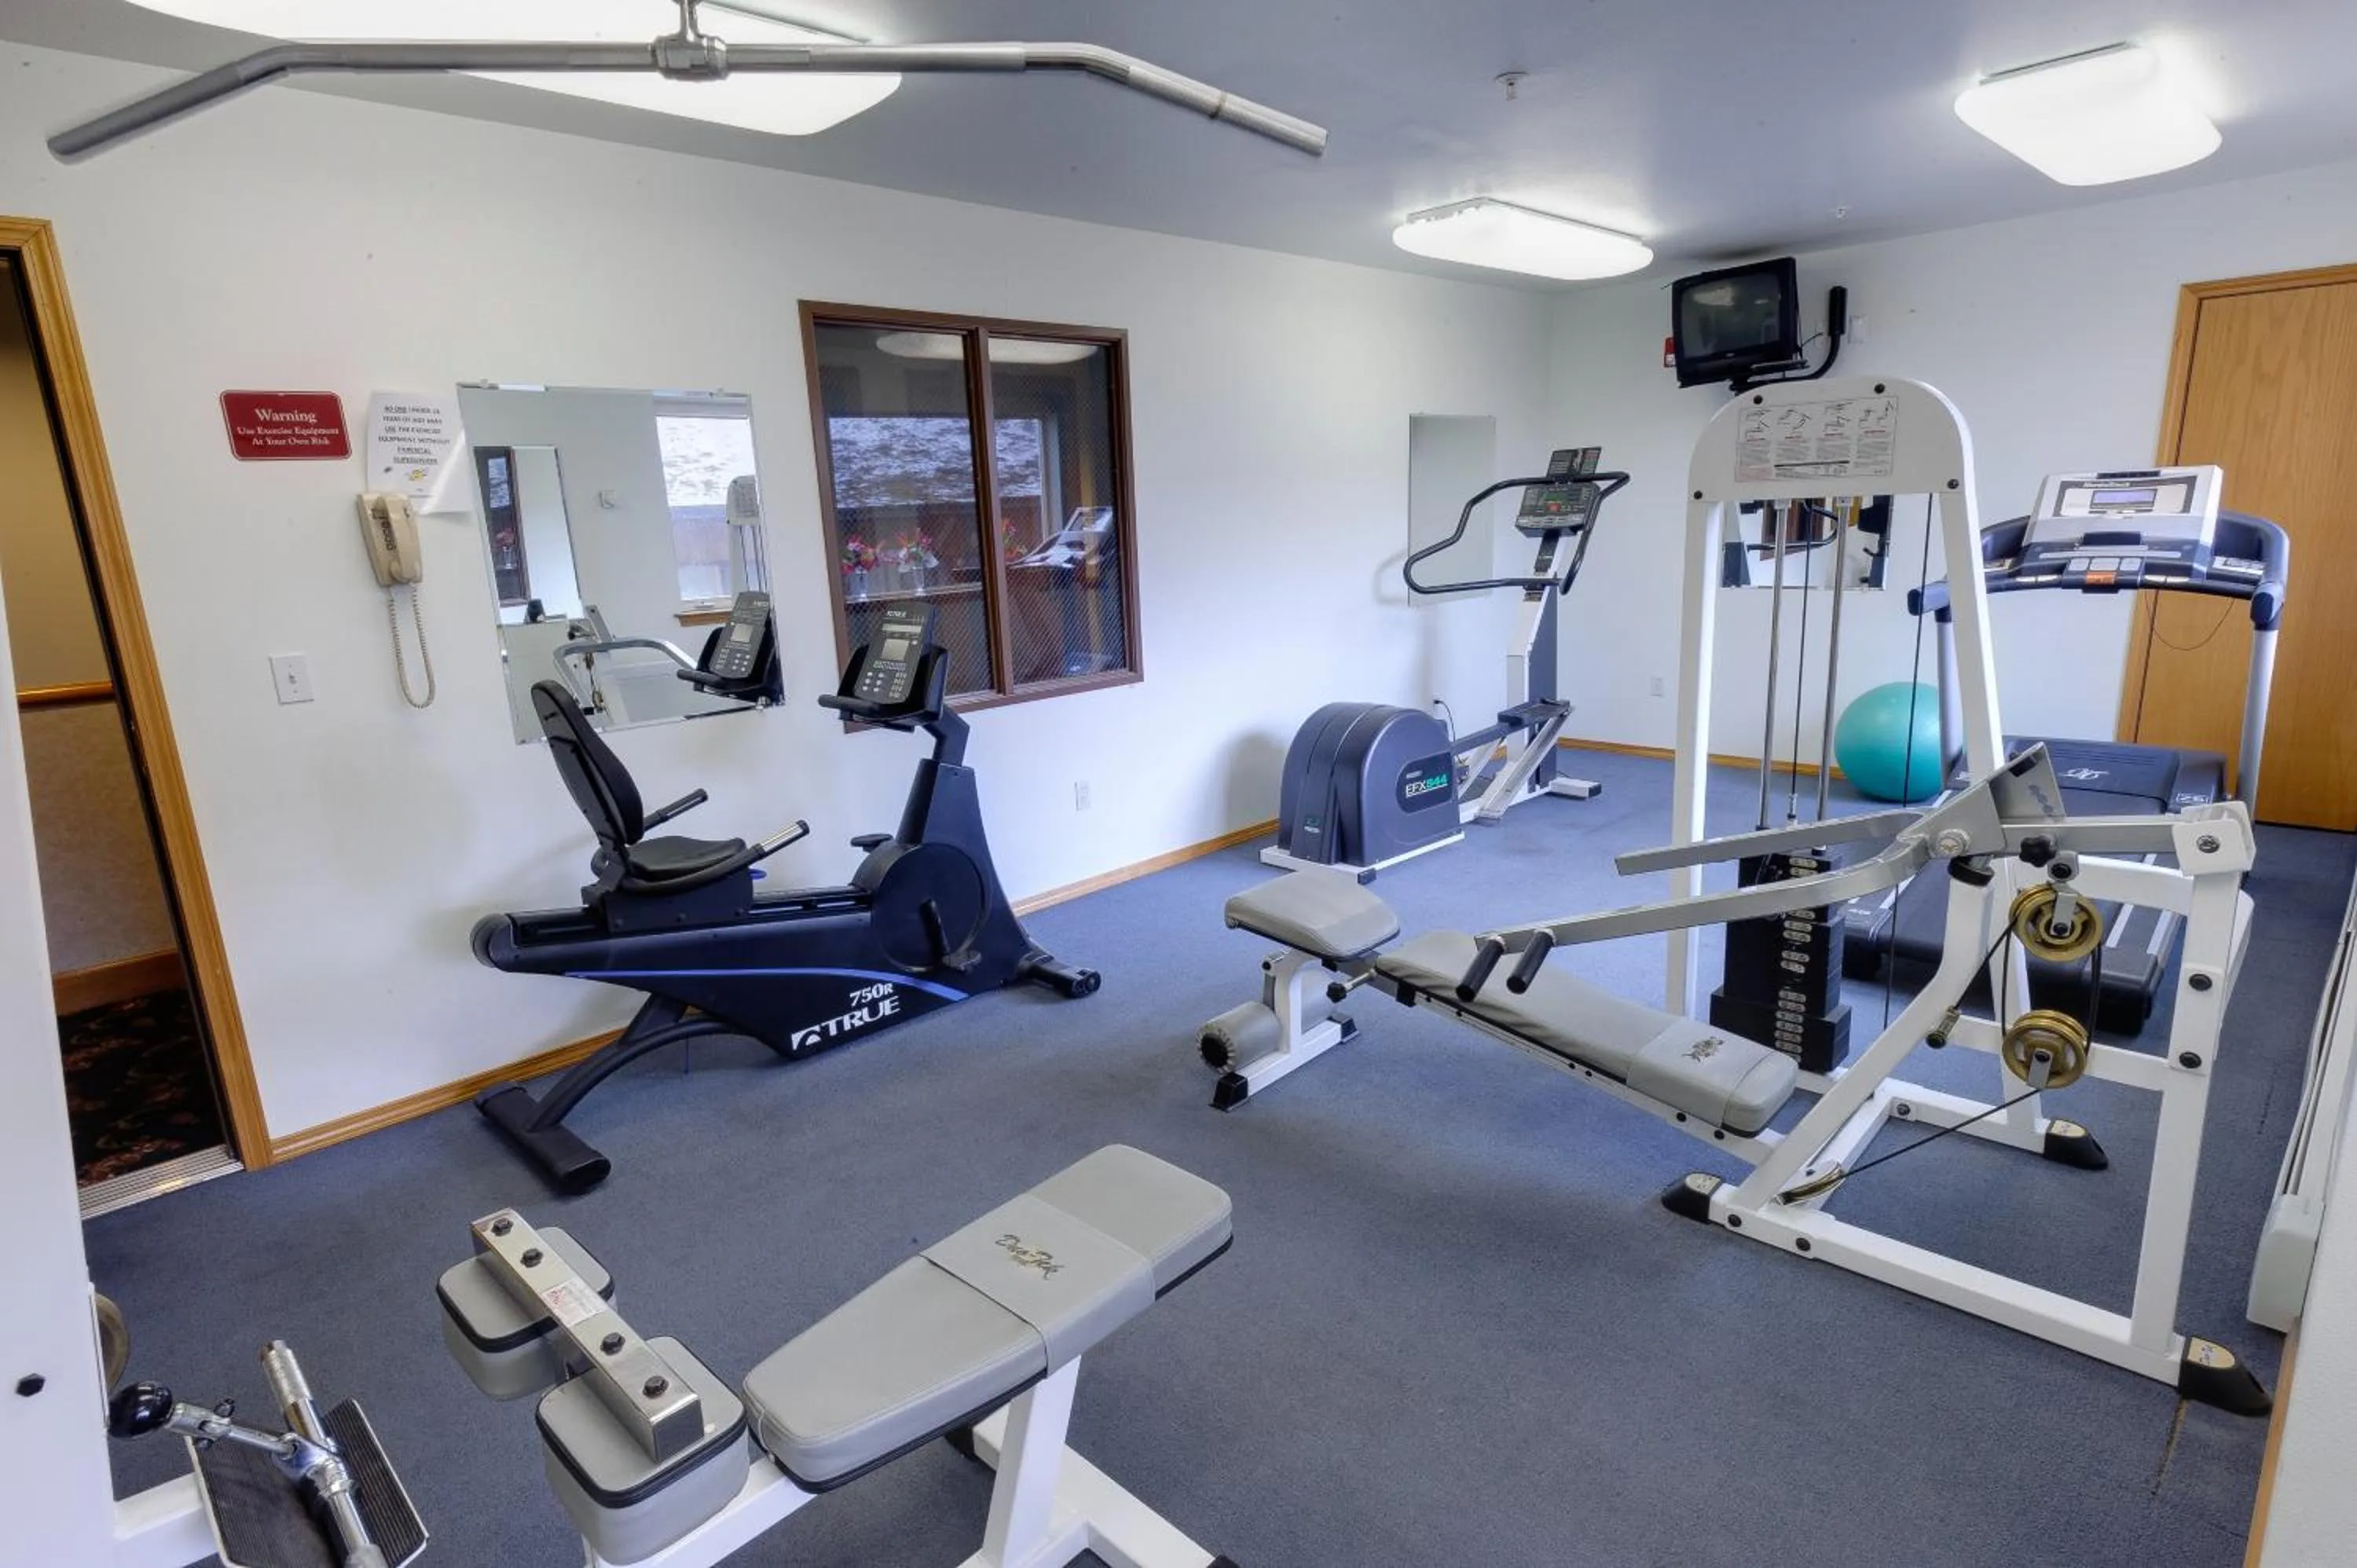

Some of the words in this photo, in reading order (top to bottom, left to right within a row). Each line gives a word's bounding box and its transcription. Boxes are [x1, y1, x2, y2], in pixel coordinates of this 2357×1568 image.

[255, 408, 317, 423] Warning
[236, 426, 255, 435] Use
[257, 426, 293, 435] Exercise
[295, 427, 339, 436] Equipment
[252, 437, 263, 446] At
[266, 437, 286, 446] Your
[288, 437, 310, 446] Own
[311, 436, 331, 445] Risk
[849, 983, 893, 1007] 750R
[821, 995, 901, 1036] TRUE
